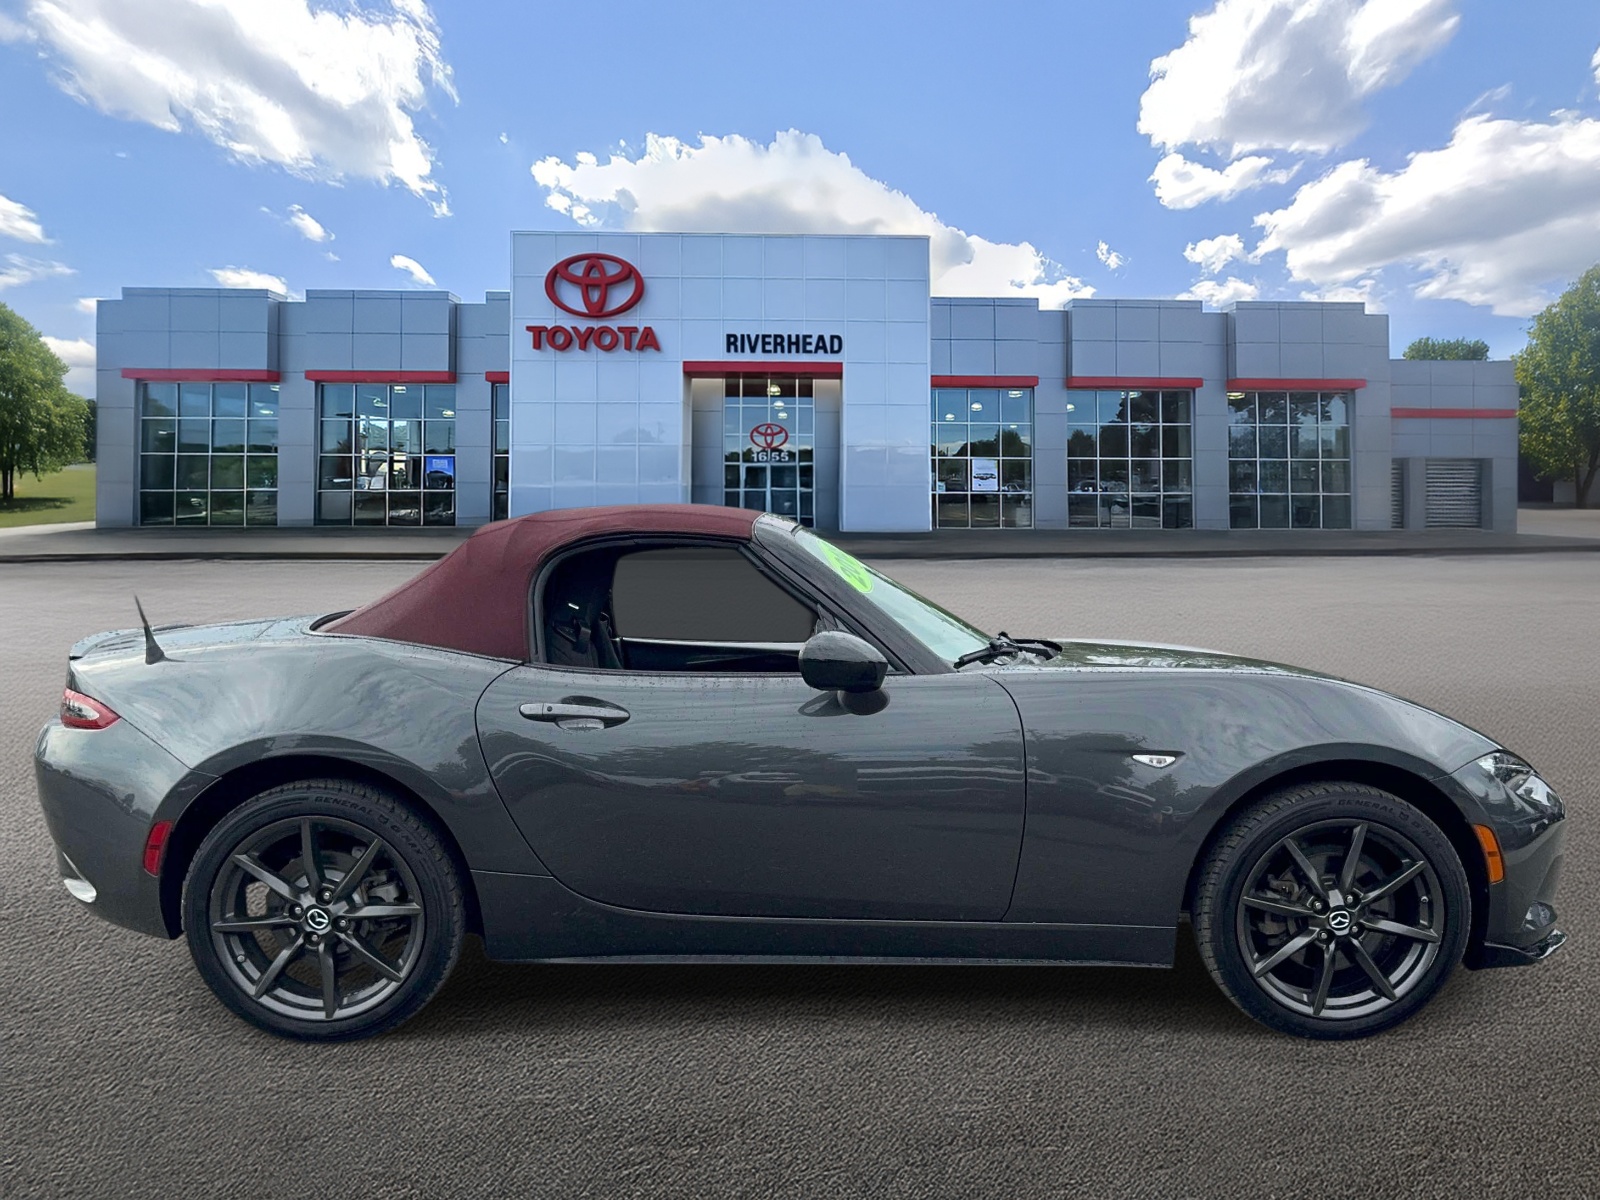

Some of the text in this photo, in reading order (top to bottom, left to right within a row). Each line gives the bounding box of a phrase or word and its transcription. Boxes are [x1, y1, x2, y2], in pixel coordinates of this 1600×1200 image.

[525, 325, 661, 352] TOYOTA
[726, 333, 843, 354] RIVERHEAD
[752, 451, 789, 462] 1655
[315, 796, 373, 815] GENERAL
[1338, 799, 1394, 814] GENERAL
